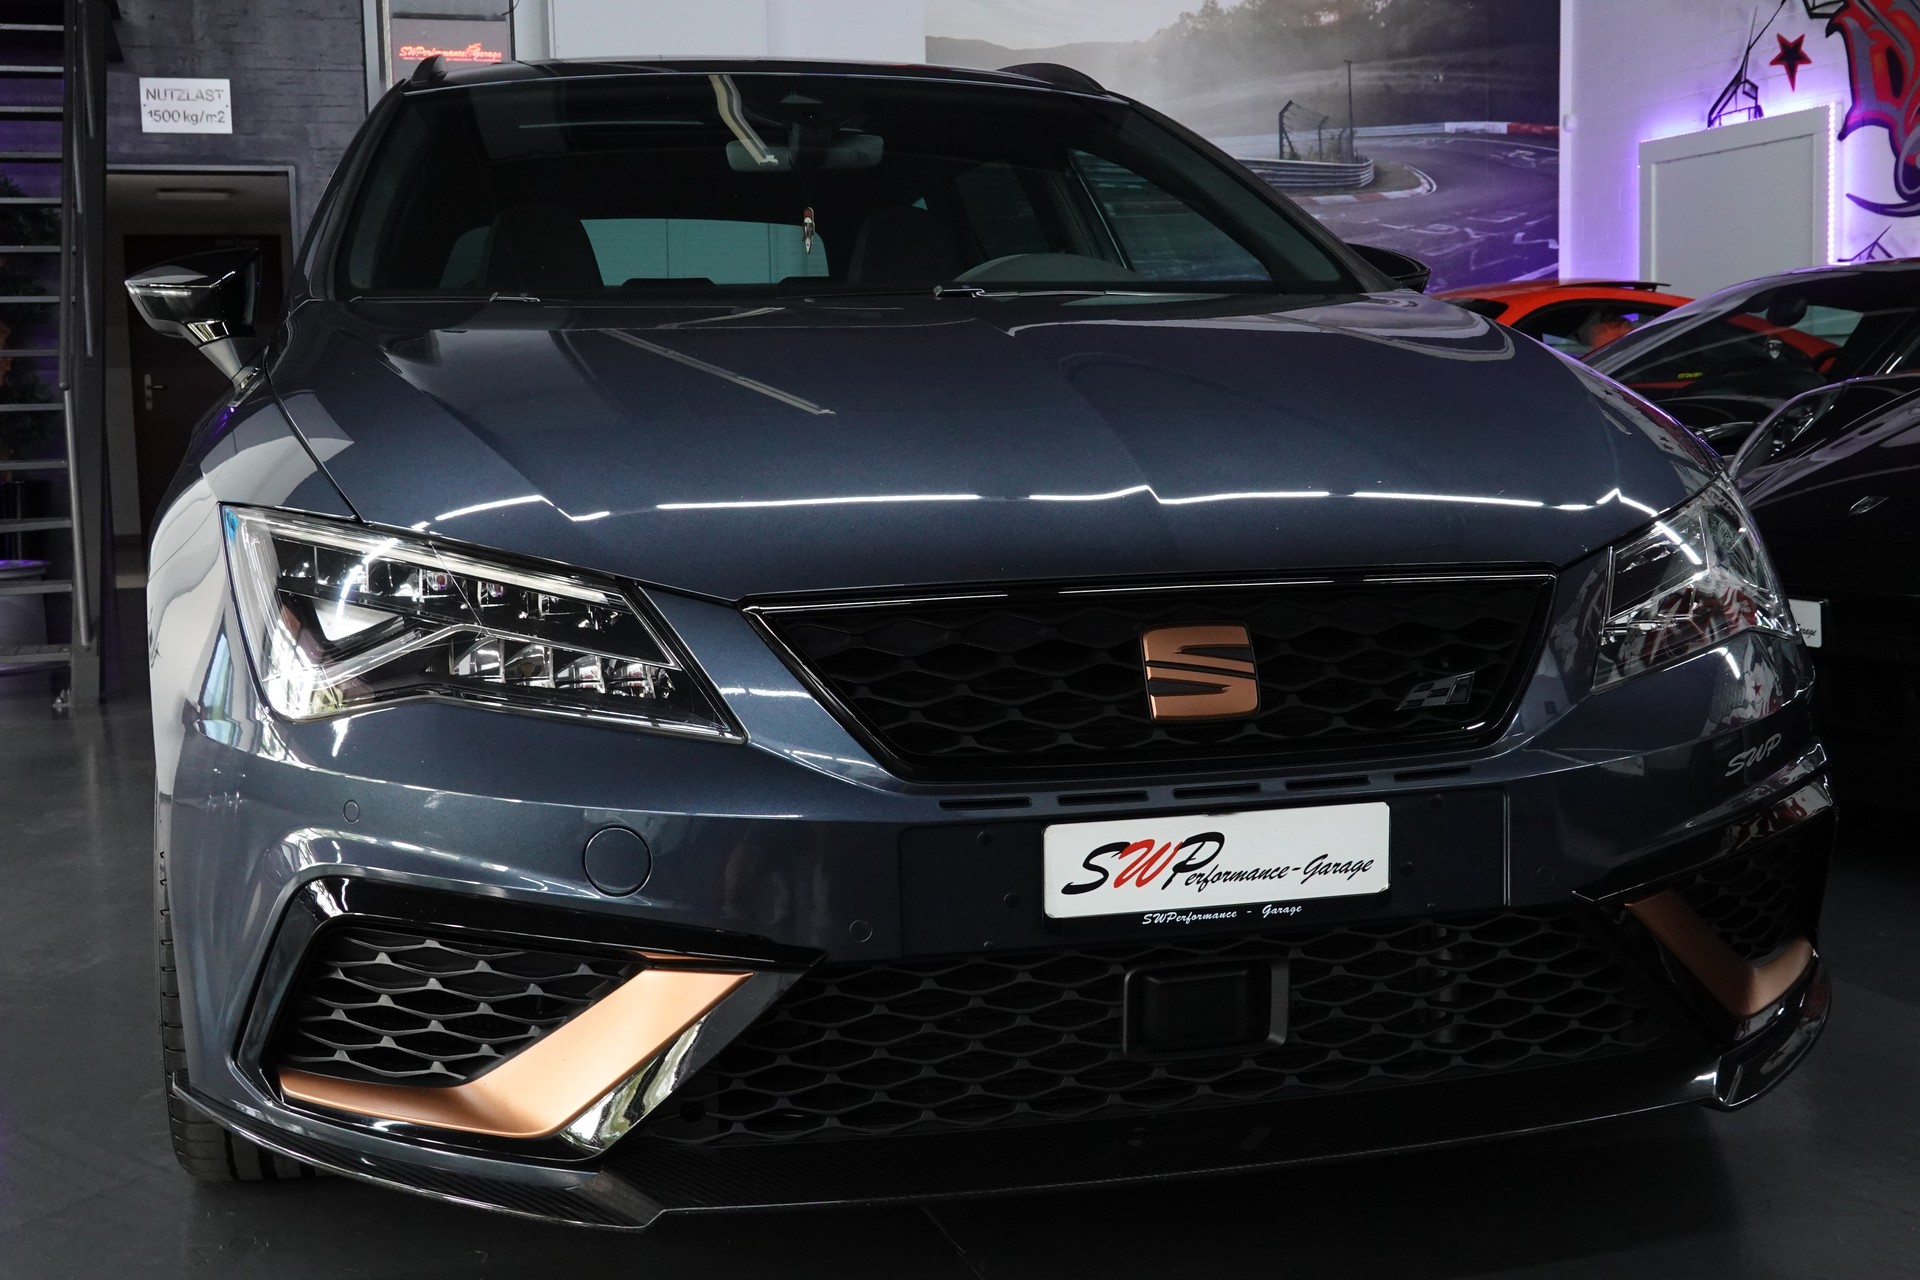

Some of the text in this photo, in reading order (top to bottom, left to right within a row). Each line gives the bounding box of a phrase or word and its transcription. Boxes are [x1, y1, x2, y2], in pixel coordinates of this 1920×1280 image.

[145, 88, 224, 102] NUTZLAST
[147, 109, 226, 125] 1500 kg/m2
[1142, 911, 1238, 925] SWPerformance
[1261, 904, 1303, 919] Garage
